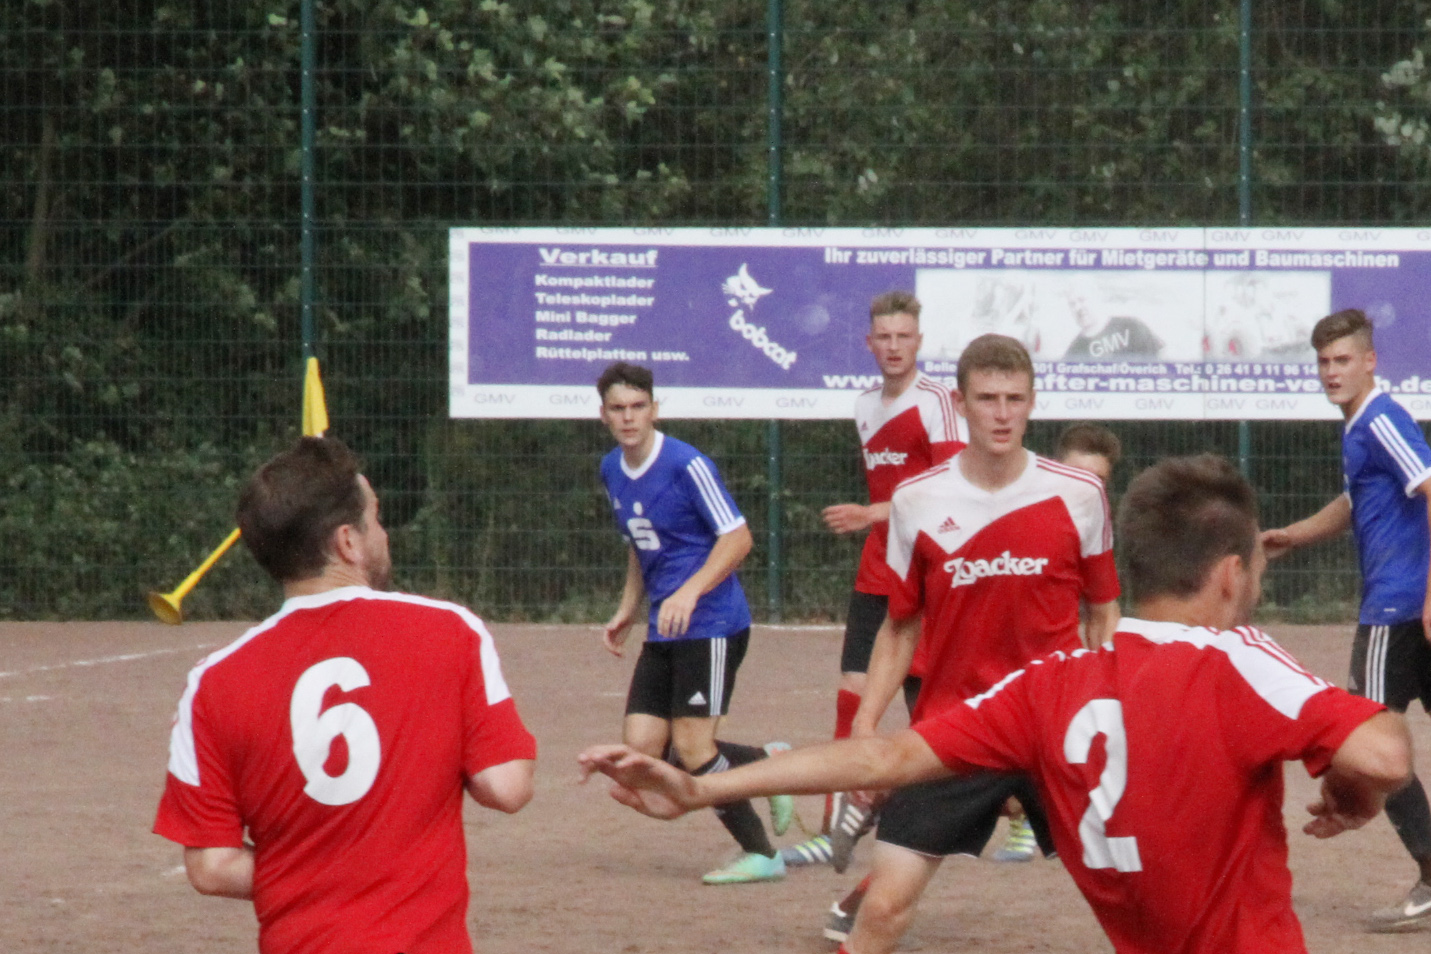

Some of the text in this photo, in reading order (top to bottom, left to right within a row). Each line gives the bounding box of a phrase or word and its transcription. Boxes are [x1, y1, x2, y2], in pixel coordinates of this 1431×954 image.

[710, 228, 750, 237] GMV
[782, 228, 824, 238] GMV
[862, 228, 903, 238] GMV
[935, 229, 977, 239] GMV
[1015, 230, 1056, 240] GMV
[1069, 231, 1108, 242] GMV
[1139, 231, 1178, 242] GMV
[1211, 231, 1250, 242] GMV
[1262, 231, 1305, 241] GMV
[1339, 231, 1381, 241] GMV
[539, 248, 659, 266] Verkauf
[824, 247, 1399, 269] Ihr zuverlässiger Partner für Mietgeräte und Baumaschinen
[534, 274, 655, 289] Kompaktlader
[534, 292, 655, 307] Teleskoplader
[535, 311, 637, 326] Mini Bagger
[535, 328, 613, 342] Radlader
[729, 308, 797, 371] bobcat
[1088, 328, 1131, 358] GMV
[535, 346, 690, 362] Rüttelplatten usw.
[1205, 364, 1214, 375] 0
[1217, 364, 1232, 375] 26
[1234, 364, 1250, 375] 41
[1253, 364, 1262, 376] 9
[1265, 364, 1280, 376] 11
[474, 393, 516, 405] GMV
[549, 394, 591, 405] GMV
[703, 396, 745, 407] GMV
[775, 397, 818, 408] GMV
[1064, 398, 1104, 410] GMV
[1135, 399, 1174, 410] GMV
[1207, 399, 1245, 410] GMV
[1256, 399, 1298, 410] GMV
[290, 656, 381, 806] 6
[1063, 698, 1143, 872] 2
